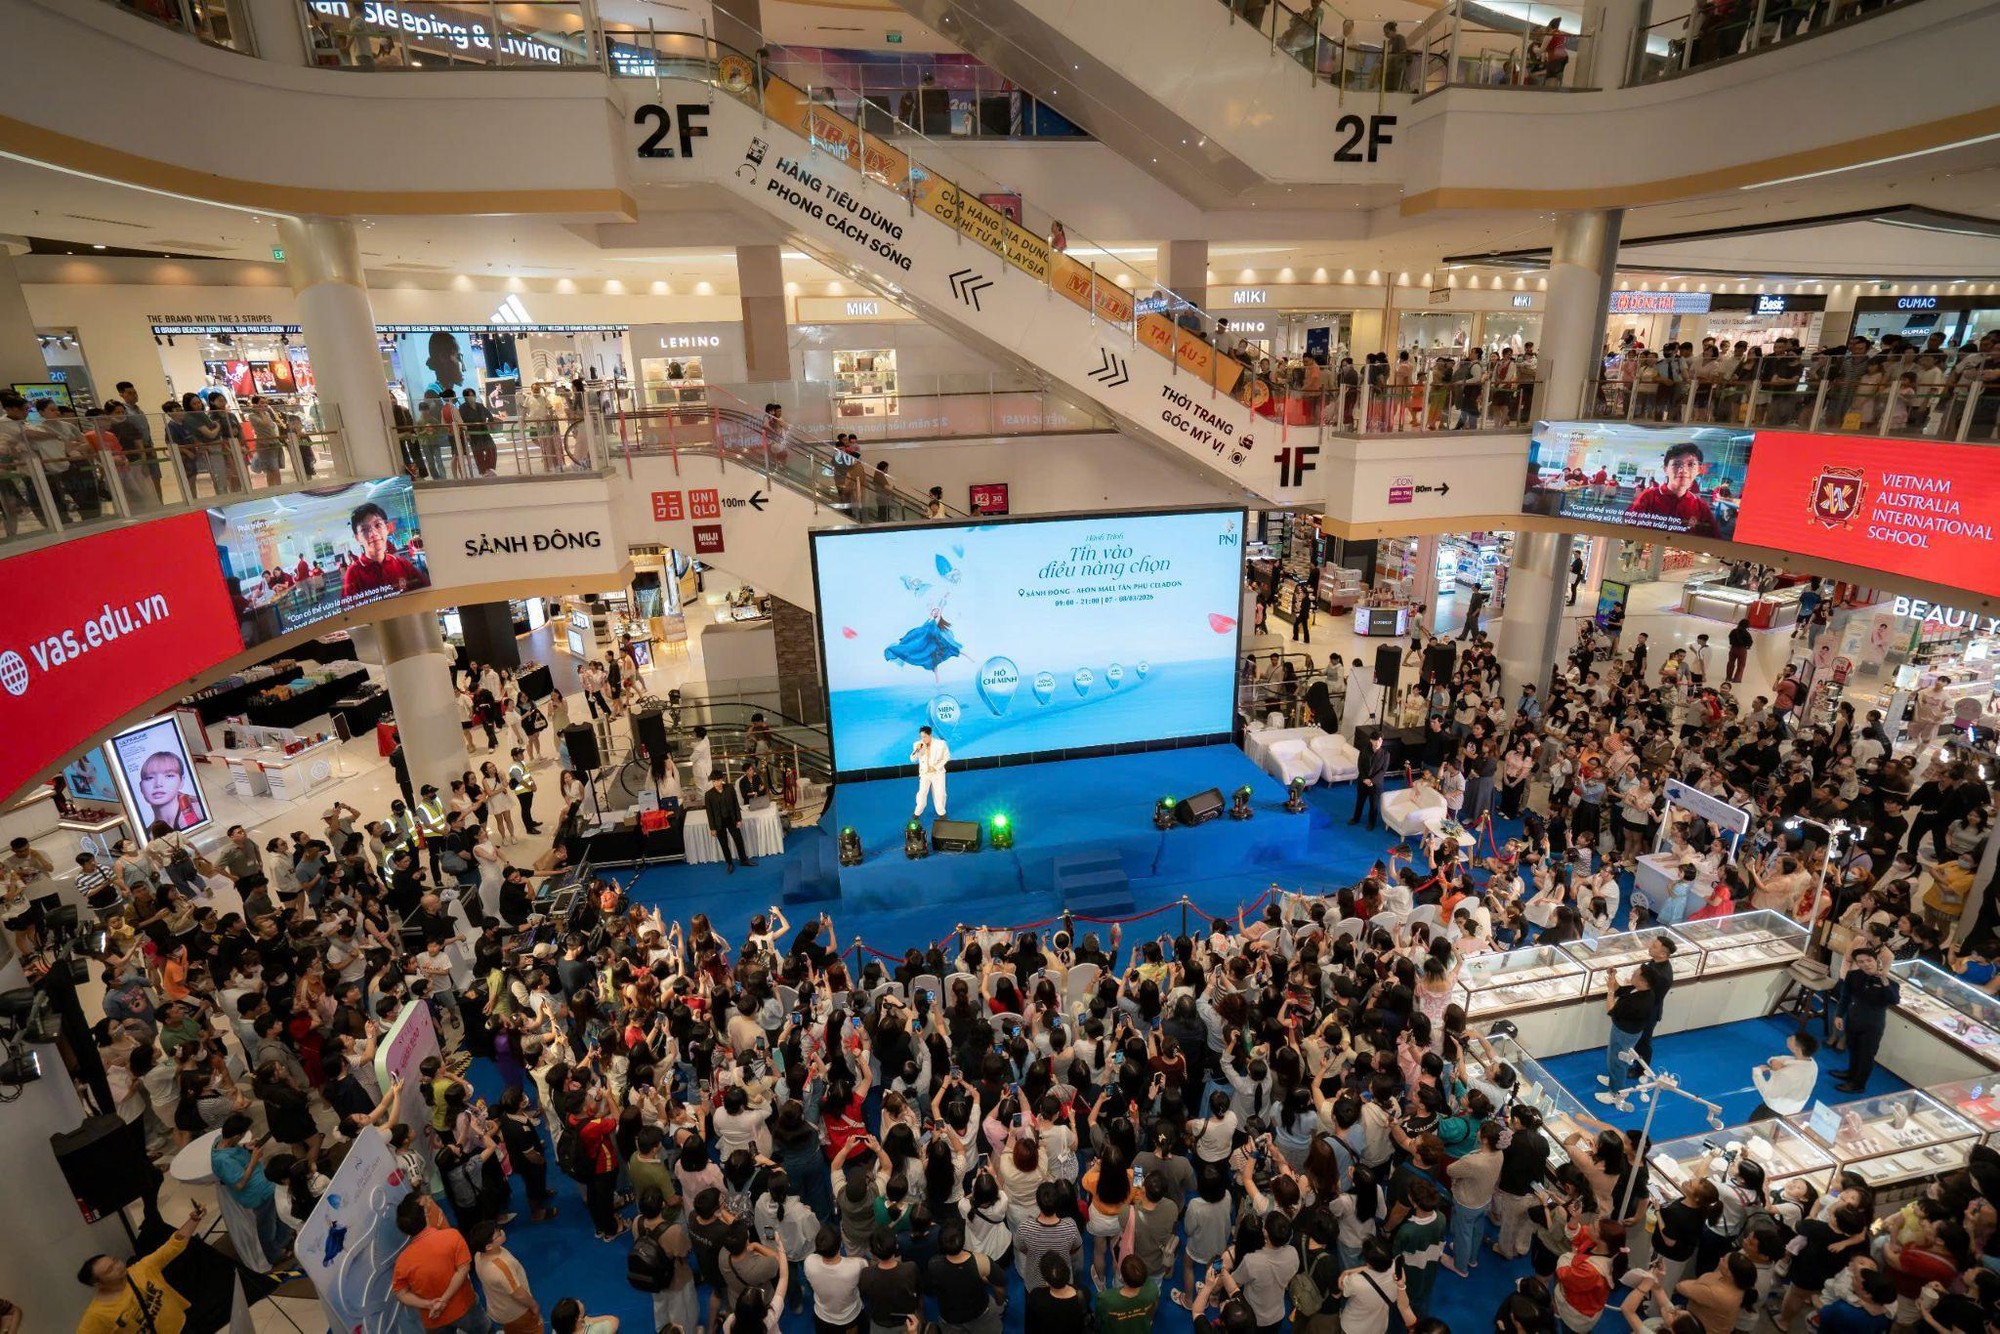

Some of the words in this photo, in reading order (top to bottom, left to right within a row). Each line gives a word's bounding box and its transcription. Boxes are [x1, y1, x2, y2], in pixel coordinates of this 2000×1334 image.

[364, 2, 468, 50] Sleeping
[473, 24, 492, 49] &
[634, 103, 710, 158] 2F
[1333, 114, 1397, 162] 2F
[775, 156, 821, 194] HÀNG
[826, 184, 857, 214] TIÊU
[858, 206, 903, 241] DÙNG
[766, 178, 822, 220] PHONG
[825, 210, 869, 246] CÁCH
[869, 240, 912, 272] SỐNG
[1233, 290, 1266, 304] MIKI
[1897, 297, 1936, 309] GUMAC
[147, 314, 162, 323] THE
[165, 314, 193, 323] BRAND
[195, 314, 216, 323] WITH
[218, 314, 234, 323] THE
[234, 314, 240, 322] 3
[242, 314, 272, 323] STRIPES
[846, 302, 878, 316] MIKI
[660, 336, 720, 349] LEMINO
[1197, 355, 1208, 367] 2
[1194, 404, 1234, 436] TRANG
[1161, 410, 1188, 432] GÓC
[1190, 426, 1212, 444] MỸ
[1211, 441, 1226, 456] VỊ
[1274, 446, 1320, 487] 1F
[1415, 485, 1432, 493] 80m
[1882, 472, 1952, 494] VIETNAM
[691, 491, 714, 503] UNI
[721, 497, 746, 508] 100m
[1876, 491, 1961, 516] AUSTRALIA
[693, 503, 717, 517] QLO
[1871, 508, 1994, 542] INTERNATIONAL
[465, 533, 528, 557] SẢNH
[532, 528, 601, 551] ĐÔNG
[698, 532, 719, 542] MUJI
[1218, 534, 1238, 546] PNJ
[1867, 525, 1930, 549] SCHOOL
[1070, 546, 1096, 562] Tin
[1103, 544, 1133, 560] vào
[1081, 562, 1124, 581] nàng
[1129, 555, 1171, 576] chọn
[30, 593, 170, 672] vas.edu.vn
[983, 677, 999, 685] CHÍ
[999, 676, 1018, 684] MINH
